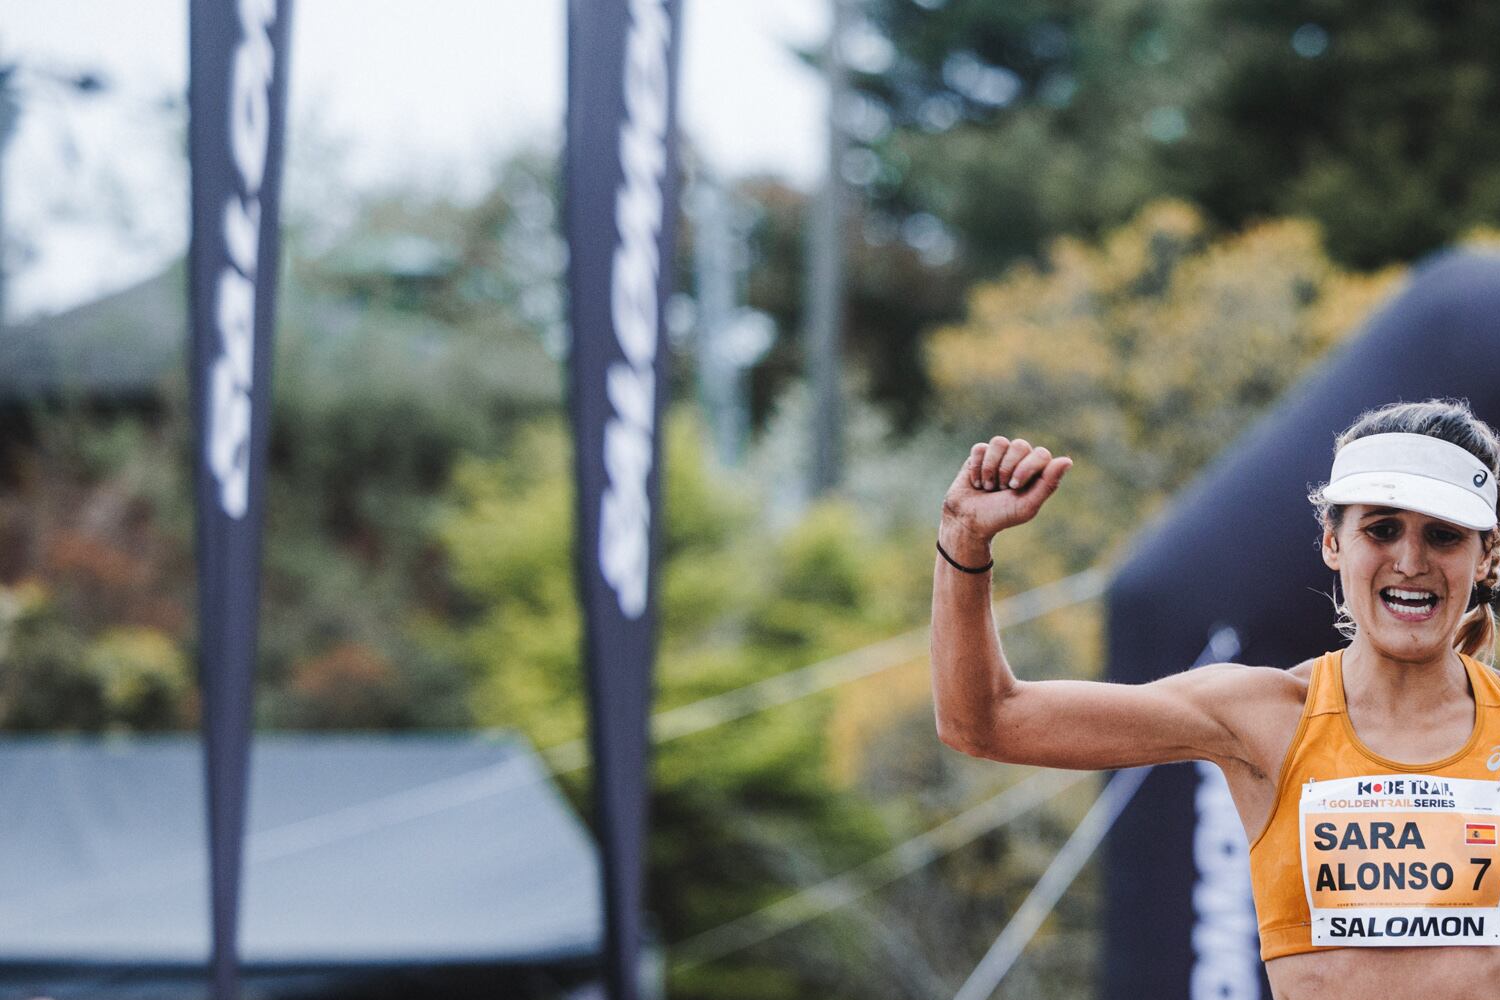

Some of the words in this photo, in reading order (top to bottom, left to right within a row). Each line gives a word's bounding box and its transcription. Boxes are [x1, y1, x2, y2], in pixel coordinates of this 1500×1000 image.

[1358, 780, 1404, 796] KOBE
[1410, 780, 1453, 796] TRAIL
[1314, 822, 1425, 850] SARA
[1315, 862, 1453, 892] ALONSO
[1470, 858, 1492, 891] 7
[1330, 916, 1485, 937] SALOMON
